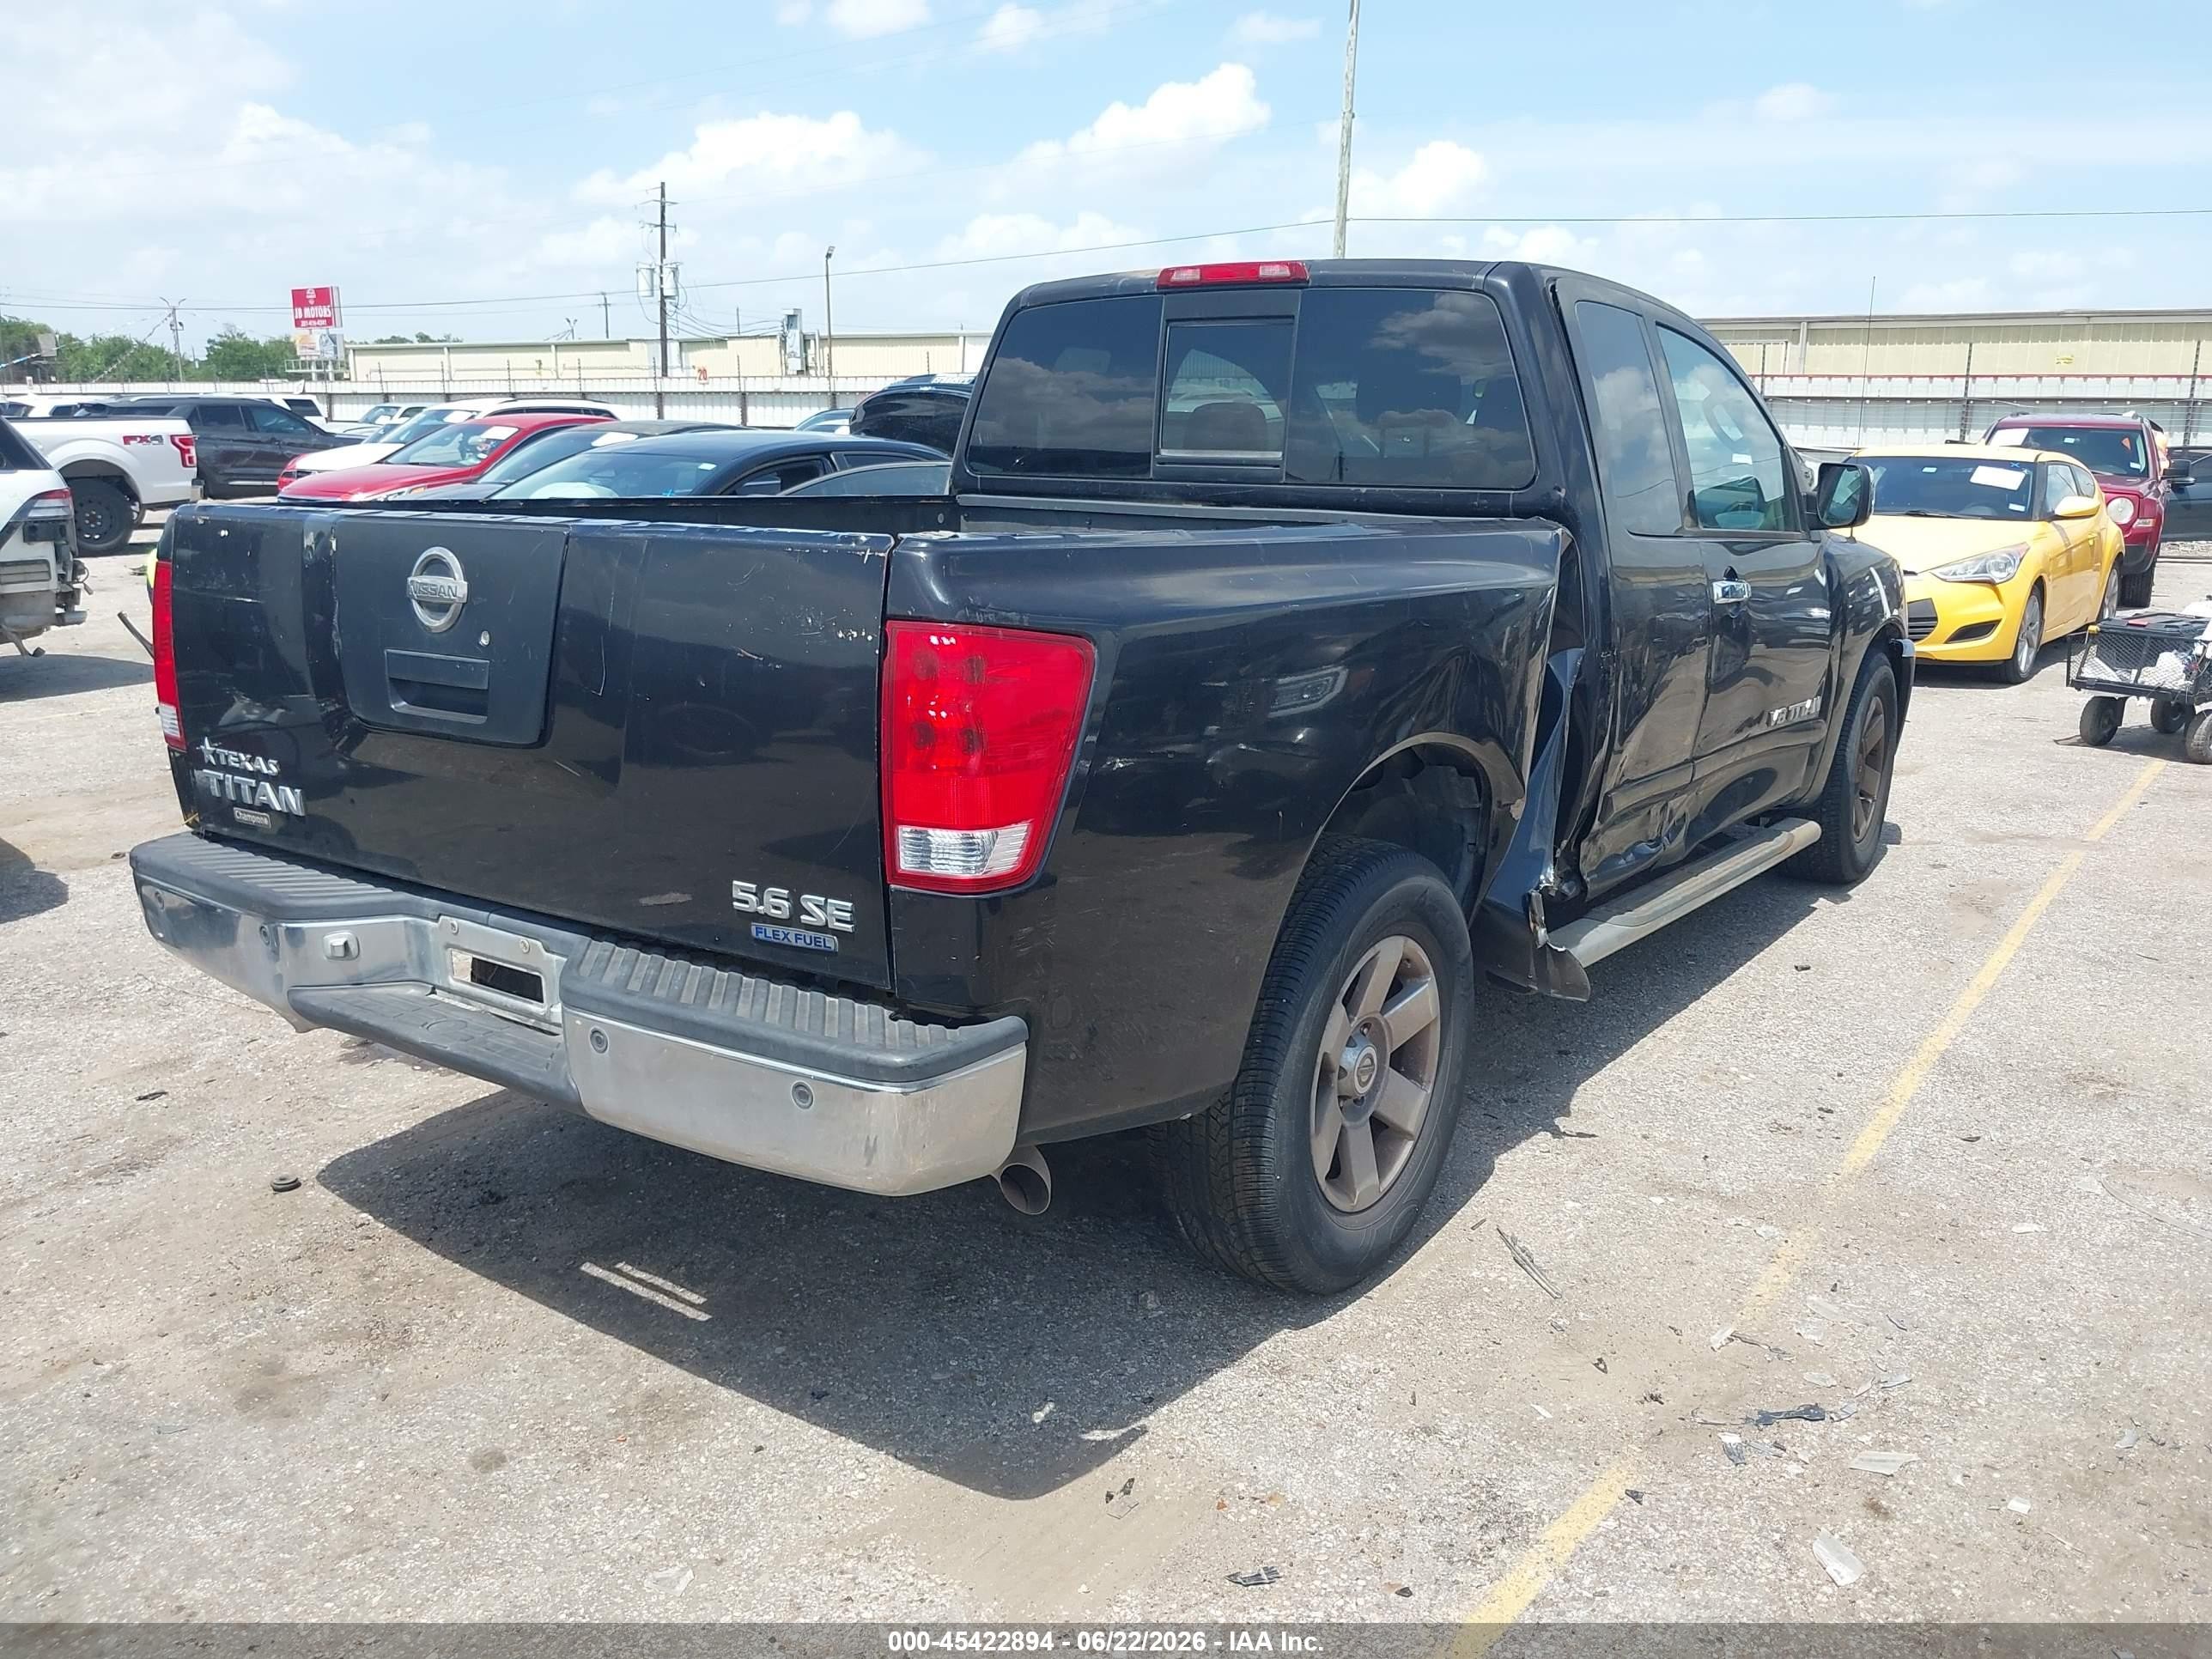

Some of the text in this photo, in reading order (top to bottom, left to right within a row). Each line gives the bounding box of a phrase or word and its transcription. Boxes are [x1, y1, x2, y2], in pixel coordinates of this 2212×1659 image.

[303, 305, 331, 319] MOTORS
[123, 434, 164, 445] FX4
[410, 580, 459, 599] NISSAN
[216, 748, 281, 776] TEXAS
[197, 769, 306, 817] TITAN
[732, 880, 855, 933] 5.6 SE
[755, 927, 833, 951] FLEX FUEL
